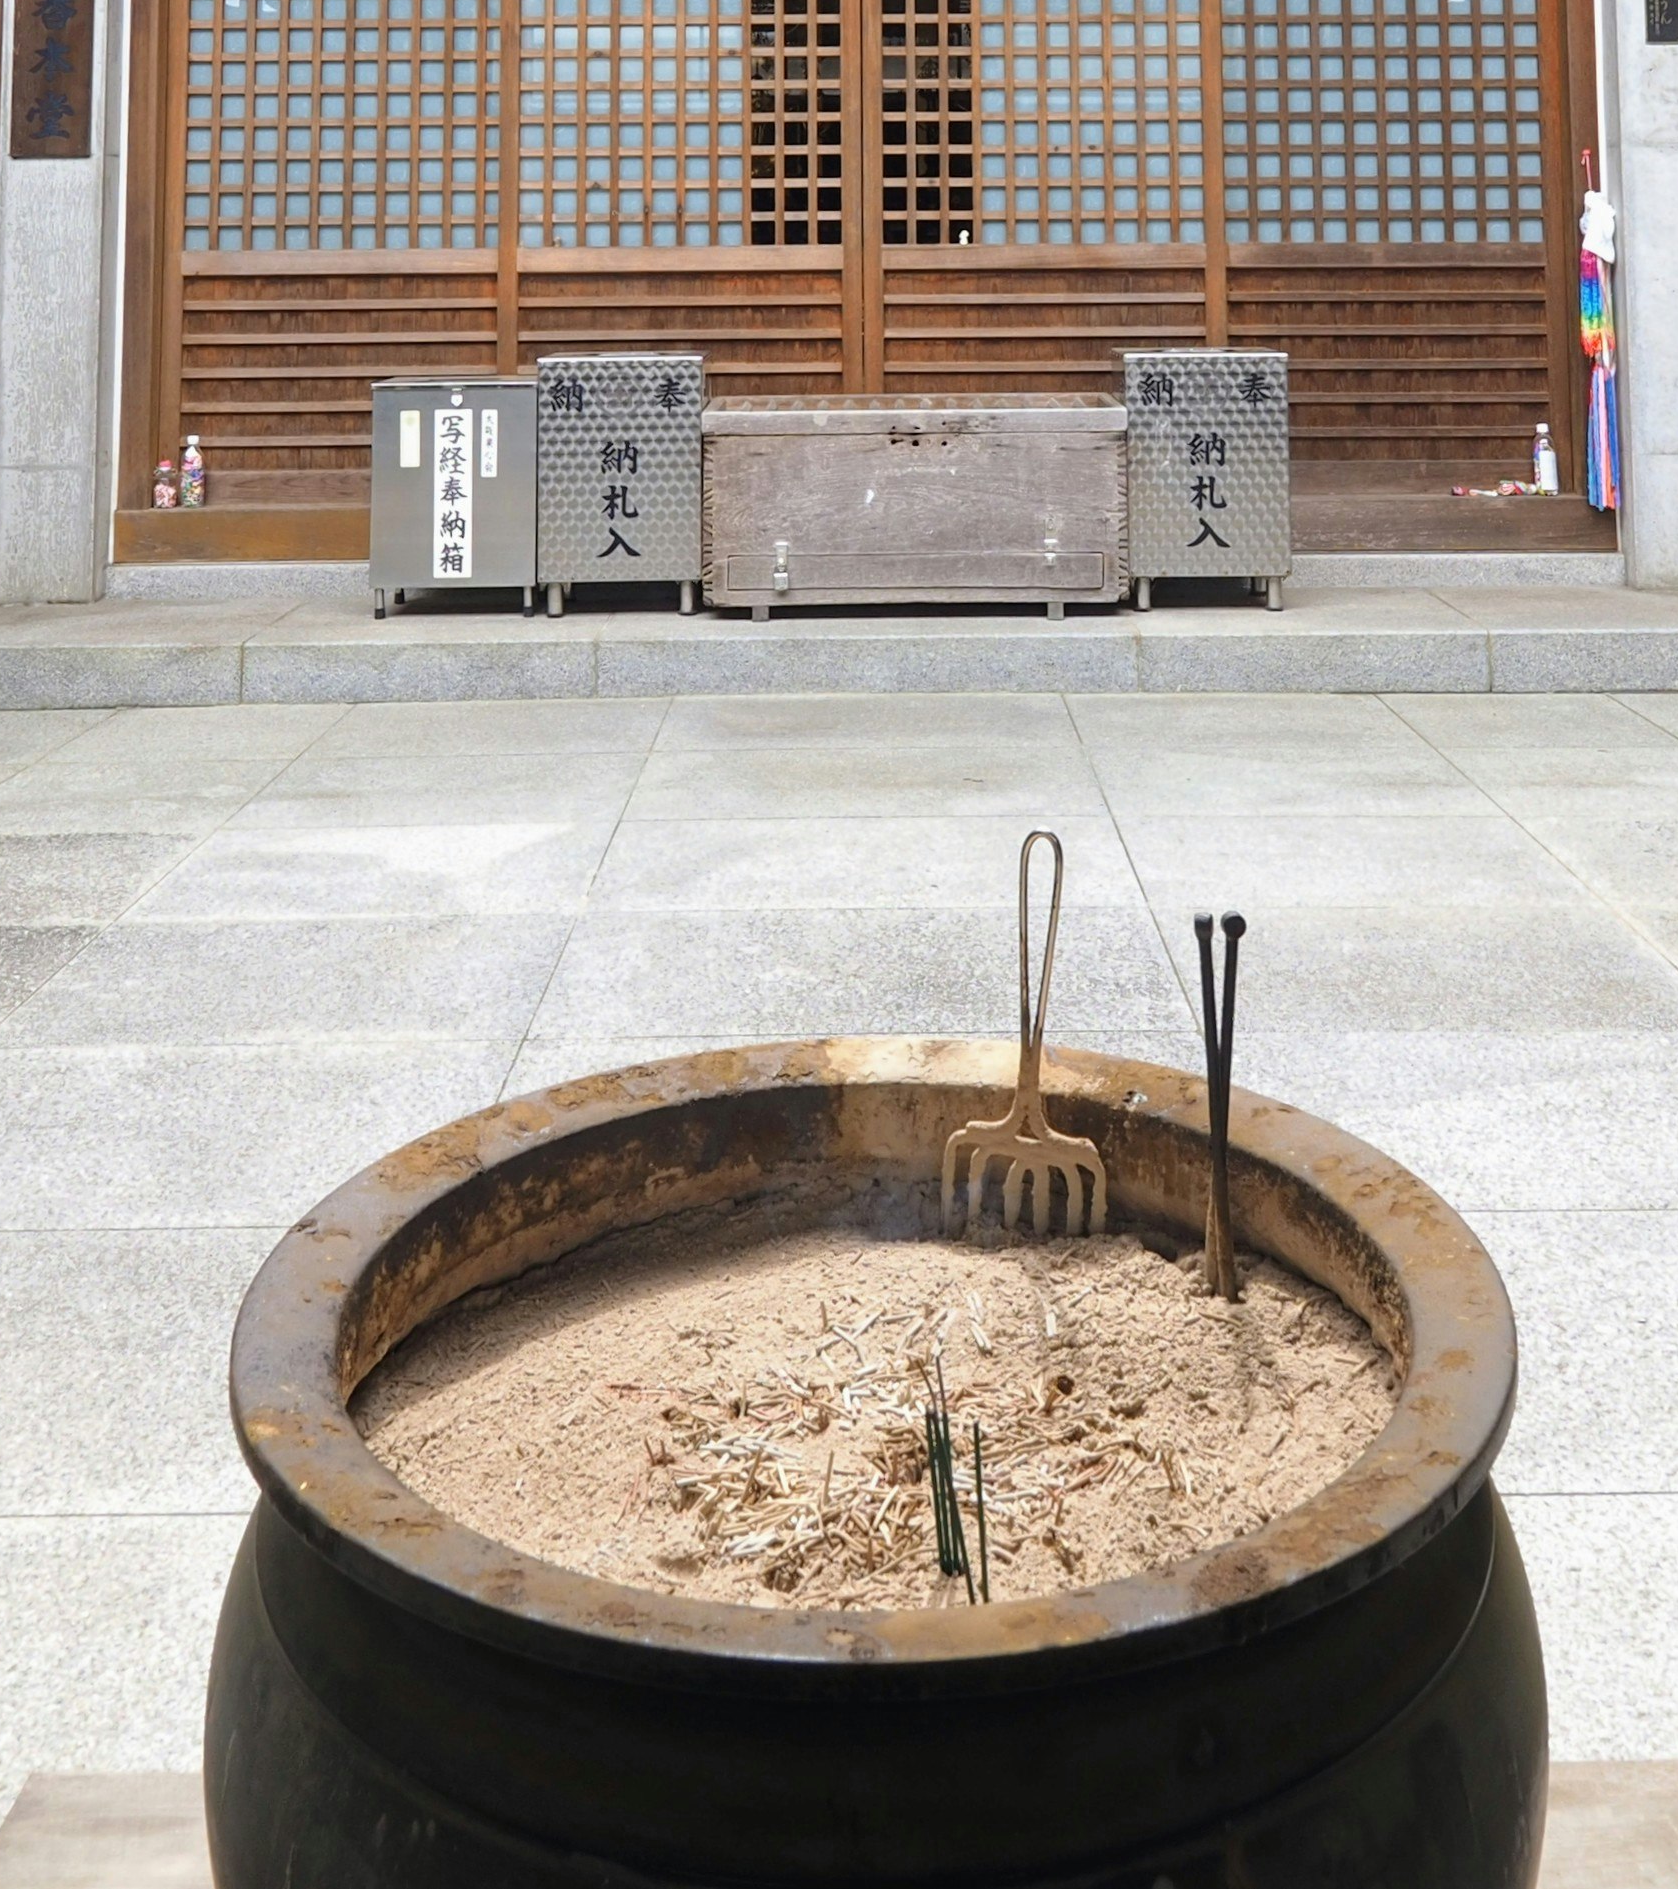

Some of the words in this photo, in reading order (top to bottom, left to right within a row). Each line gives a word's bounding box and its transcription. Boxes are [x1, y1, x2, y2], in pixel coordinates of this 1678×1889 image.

[549, 379, 585, 412] 納
[654, 378, 687, 412] 奉
[1137, 373, 1174, 407] 納
[1238, 373, 1271, 408] 奉
[439, 415, 467, 573] 写経奉納箱
[596, 440, 641, 557] 納札入
[1187, 432, 1231, 548] 納札入
